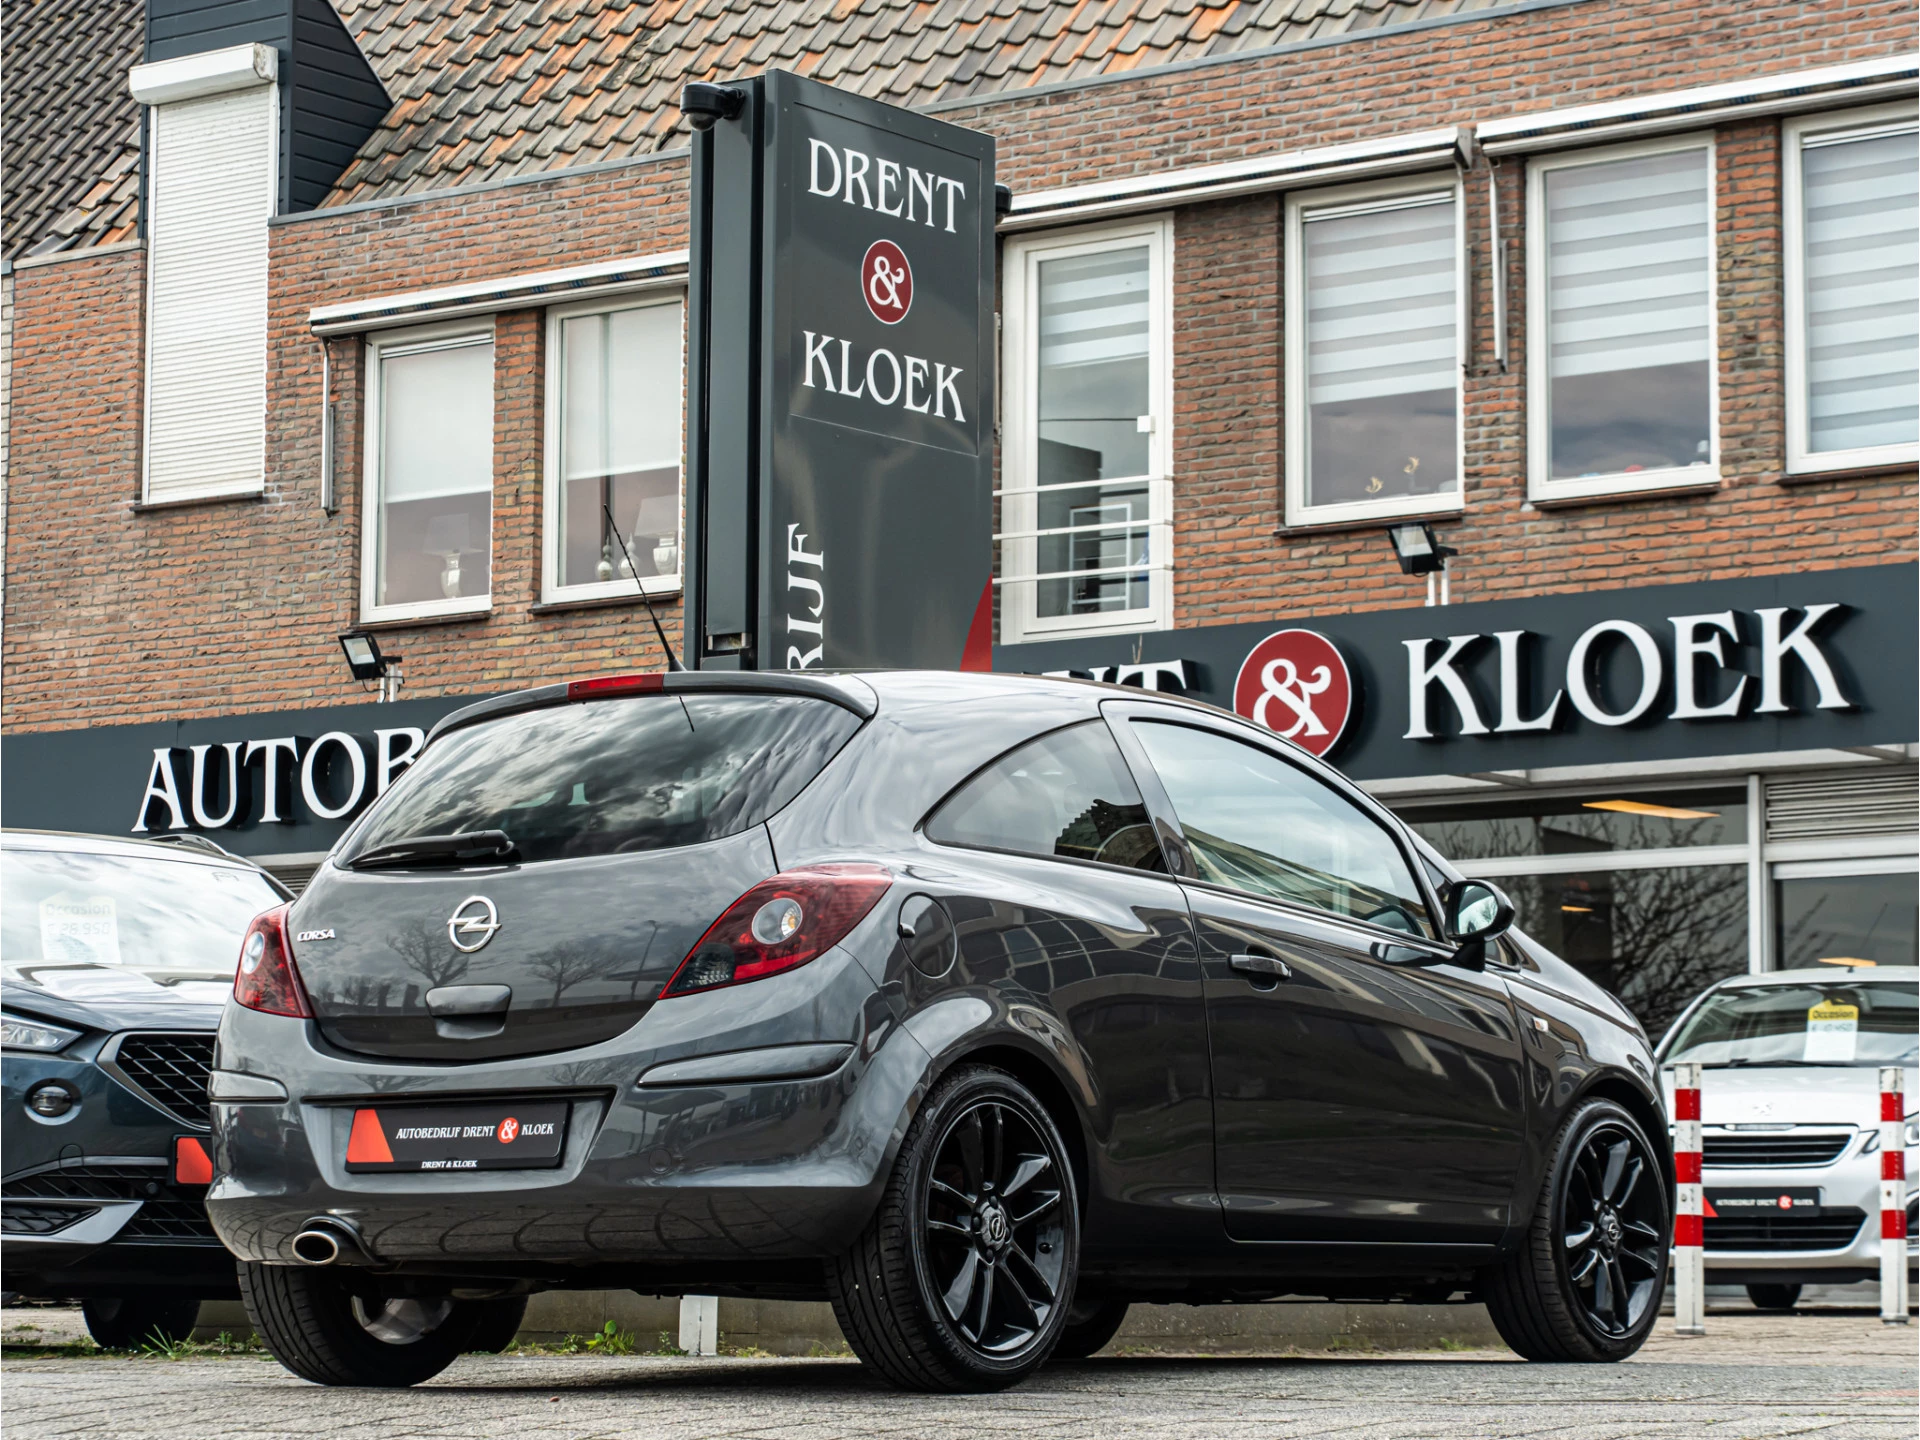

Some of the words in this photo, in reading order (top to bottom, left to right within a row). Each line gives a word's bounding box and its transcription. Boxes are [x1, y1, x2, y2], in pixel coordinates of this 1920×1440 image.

[808, 138, 965, 233] DRENT
[870, 255, 905, 309] &
[803, 331, 965, 422] KLOEK
[1253, 658, 1332, 738] &
[1402, 603, 1850, 739] KLOEK
[46, 903, 112, 916] Occasion
[297, 928, 336, 942] CORSA
[1812, 1010, 1855, 1019] Occasion
[396, 1127, 460, 1139] AUTOBEDRIJF
[463, 1125, 495, 1138] DRENT
[501, 1119, 517, 1139] &
[521, 1123, 554, 1135] KLOEK
[421, 1160, 446, 1169] DRENT
[452, 1159, 477, 1168] KLOEK
